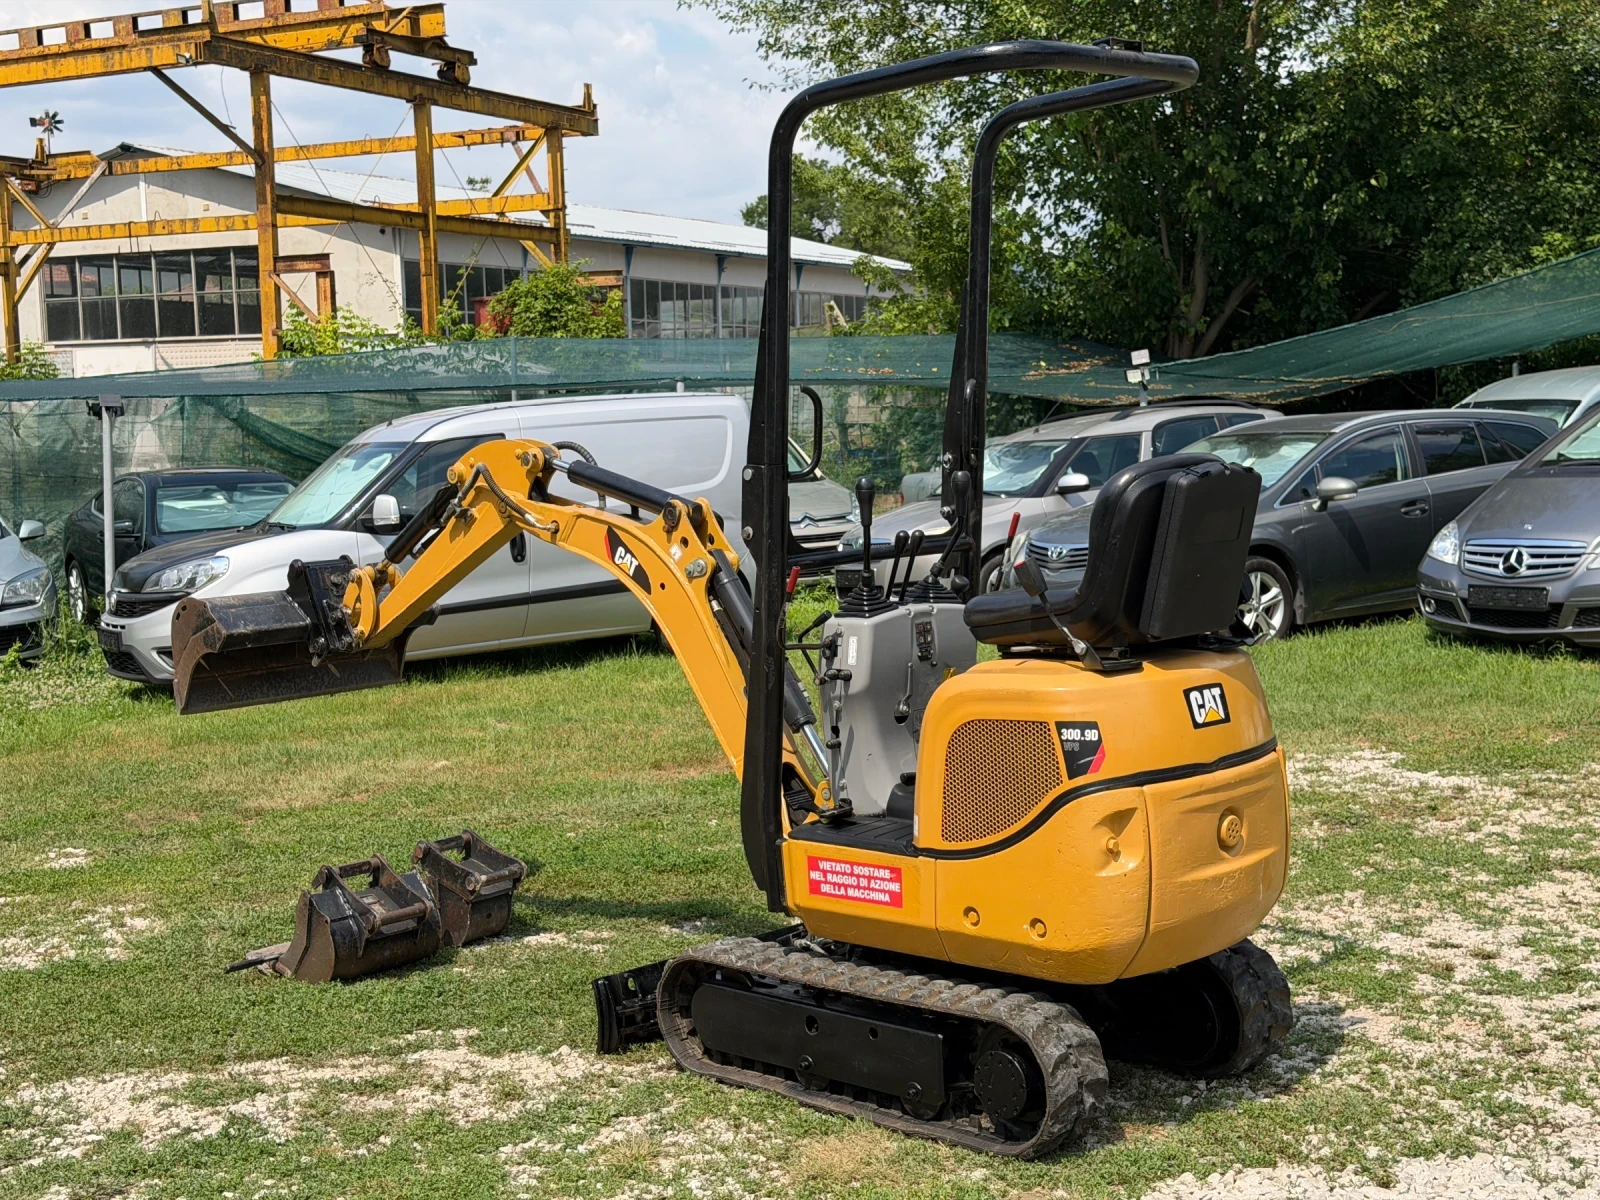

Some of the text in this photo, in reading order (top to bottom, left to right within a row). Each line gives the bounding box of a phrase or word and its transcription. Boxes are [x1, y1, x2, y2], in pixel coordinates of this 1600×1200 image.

[614, 546, 639, 577] CAT
[1189, 686, 1225, 724] CAT
[1061, 728, 1099, 741] 300.9D
[818, 860, 891, 879] VIETATO SOSTARE
[809, 870, 901, 892] NEL RAGGIO DI AZIONE
[820, 883, 891, 903] DELLA MACCHINA
